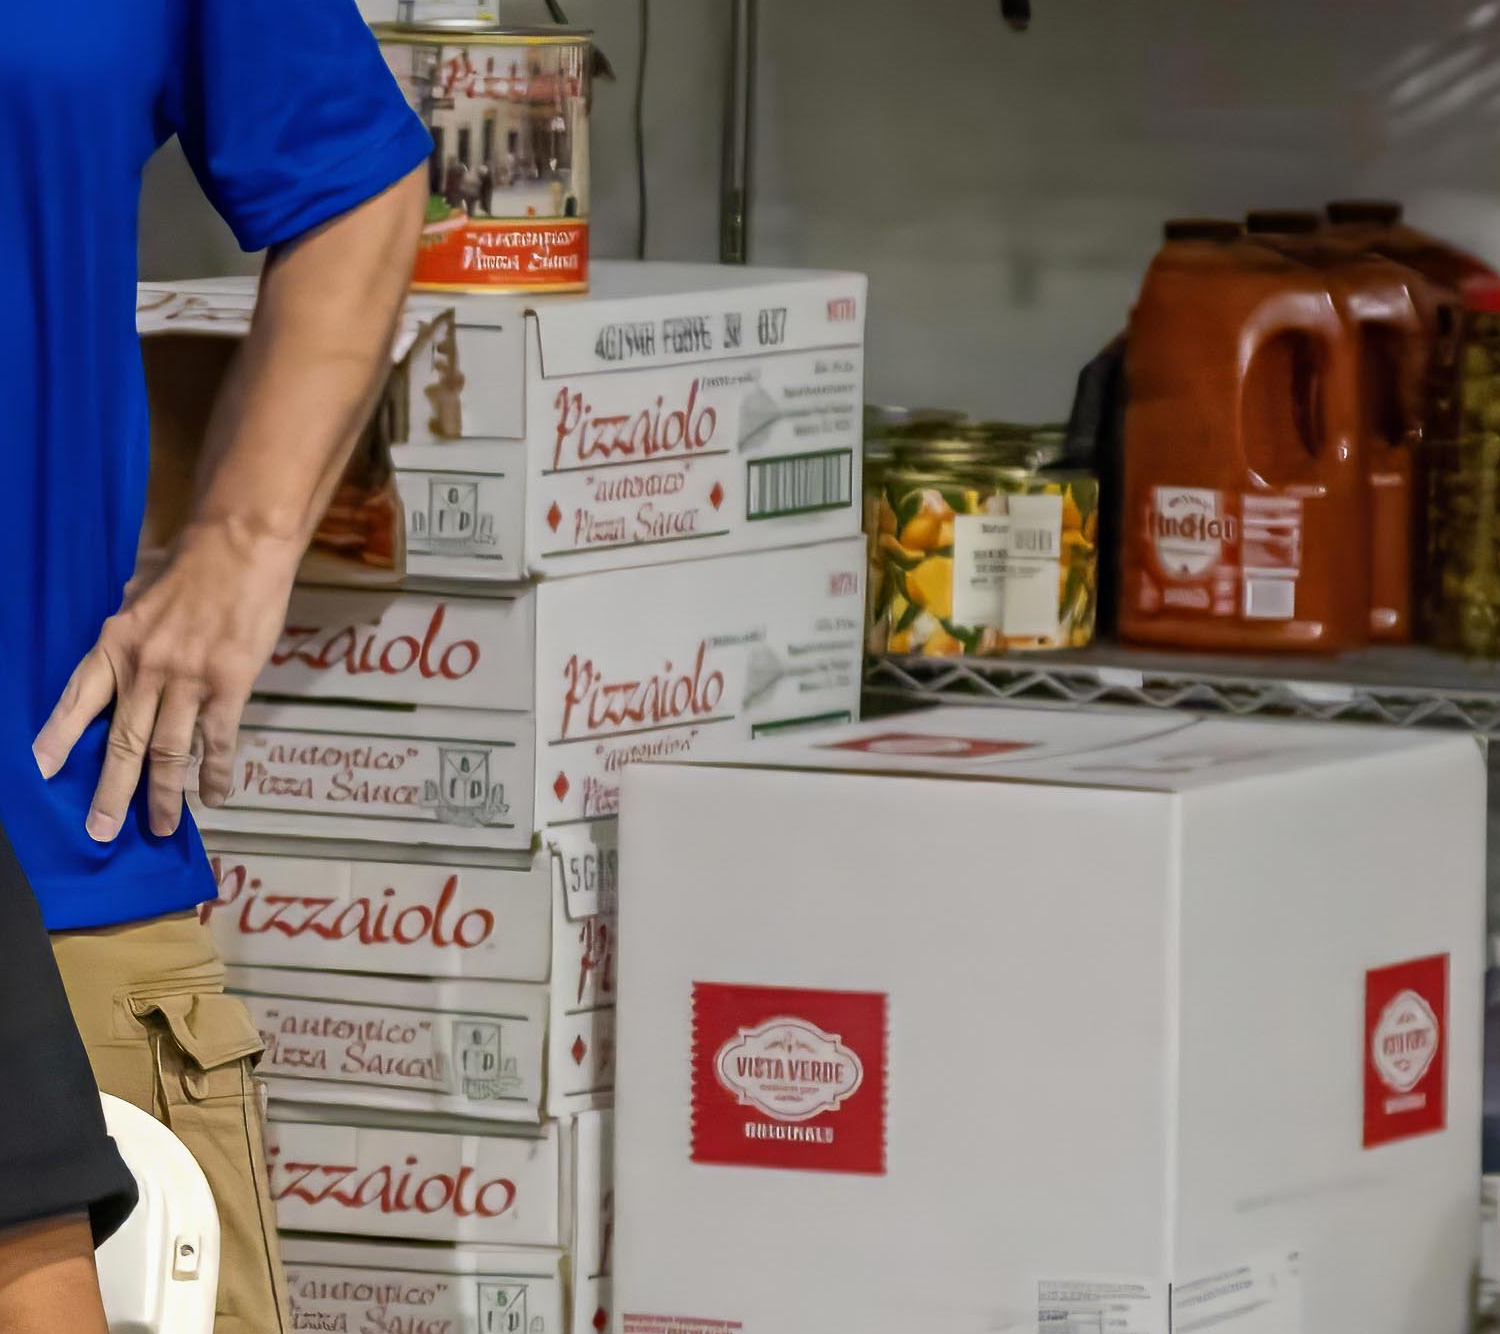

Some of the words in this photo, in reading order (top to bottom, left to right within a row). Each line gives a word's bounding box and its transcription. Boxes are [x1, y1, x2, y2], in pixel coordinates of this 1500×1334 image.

[201, 856, 495, 950] Pizzaiolo
[736, 1056, 784, 1080] VISTA
[787, 1058, 845, 1084] VERDE
[267, 1145, 517, 1217] izzaiolo
